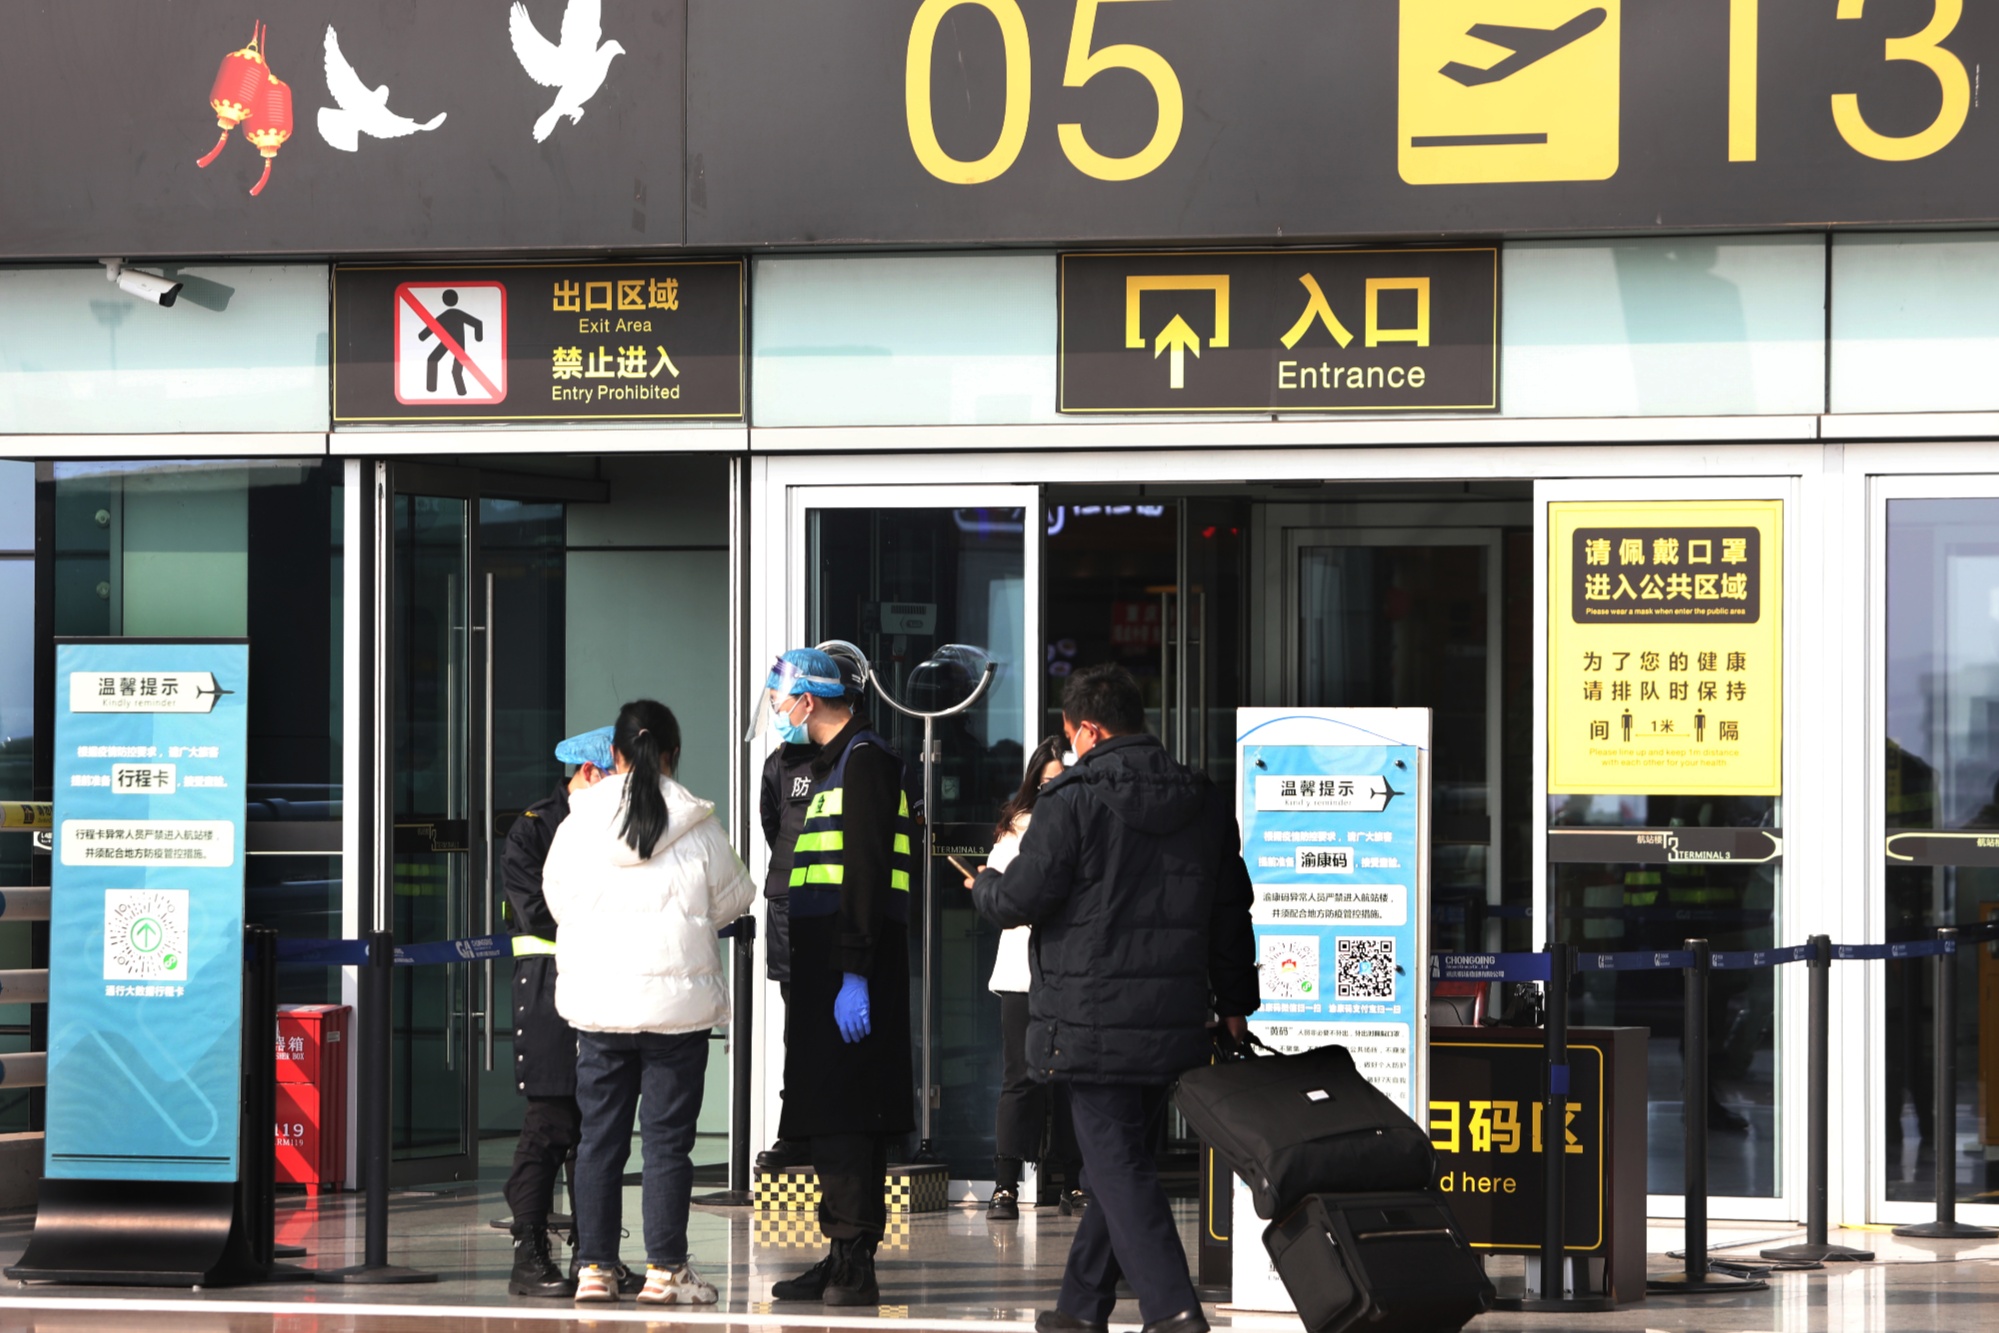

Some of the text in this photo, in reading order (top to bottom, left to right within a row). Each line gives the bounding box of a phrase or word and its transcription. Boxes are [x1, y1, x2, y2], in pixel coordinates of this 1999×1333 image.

[905, 0, 1184, 185] 05
[553, 278, 679, 312] 出口区域
[1279, 272, 1430, 350] 入口
[579, 318, 652, 333] Exit Area
[552, 345, 680, 380] 禁止进入
[1278, 360, 1426, 389] Entrance
[552, 384, 680, 404] Entry Prohibited
[1585, 538, 1748, 566] 请佩戴口罩
[1585, 573, 1748, 601] 进入公共区域
[1586, 607, 1609, 615] Please
[1635, 607, 1652, 615] mask
[1653, 607, 1673, 615] when
[1694, 607, 1705, 615] the
[1707, 607, 1728, 616] public
[1583, 651, 1747, 672] 为了您的健康
[98, 677, 179, 696] 温馨提示
[1583, 680, 1747, 701] 请排队时保持
[102, 699, 176, 708] Kindly reminder
[1590, 719, 1739, 741] 间 1米 隔
[1589, 748, 1617, 756] Please
[1619, 748, 1634, 756] line
[1636, 750, 1647, 758] up
[1648, 748, 1664, 756] and
[1666, 748, 1686, 758] keep
[1703, 748, 1739, 756] distance
[118, 769, 169, 788] 行程卡
[791, 776, 811, 797] 防
[1281, 780, 1354, 797] 温馨提示
[936, 846, 977, 854] TERMINAL
[1301, 852, 1347, 868] 渝康码
[1679, 851, 1723, 859] TERMINAL
[1445, 956, 1495, 965] CHONGQING
[1462, 1171, 1517, 1193] here
